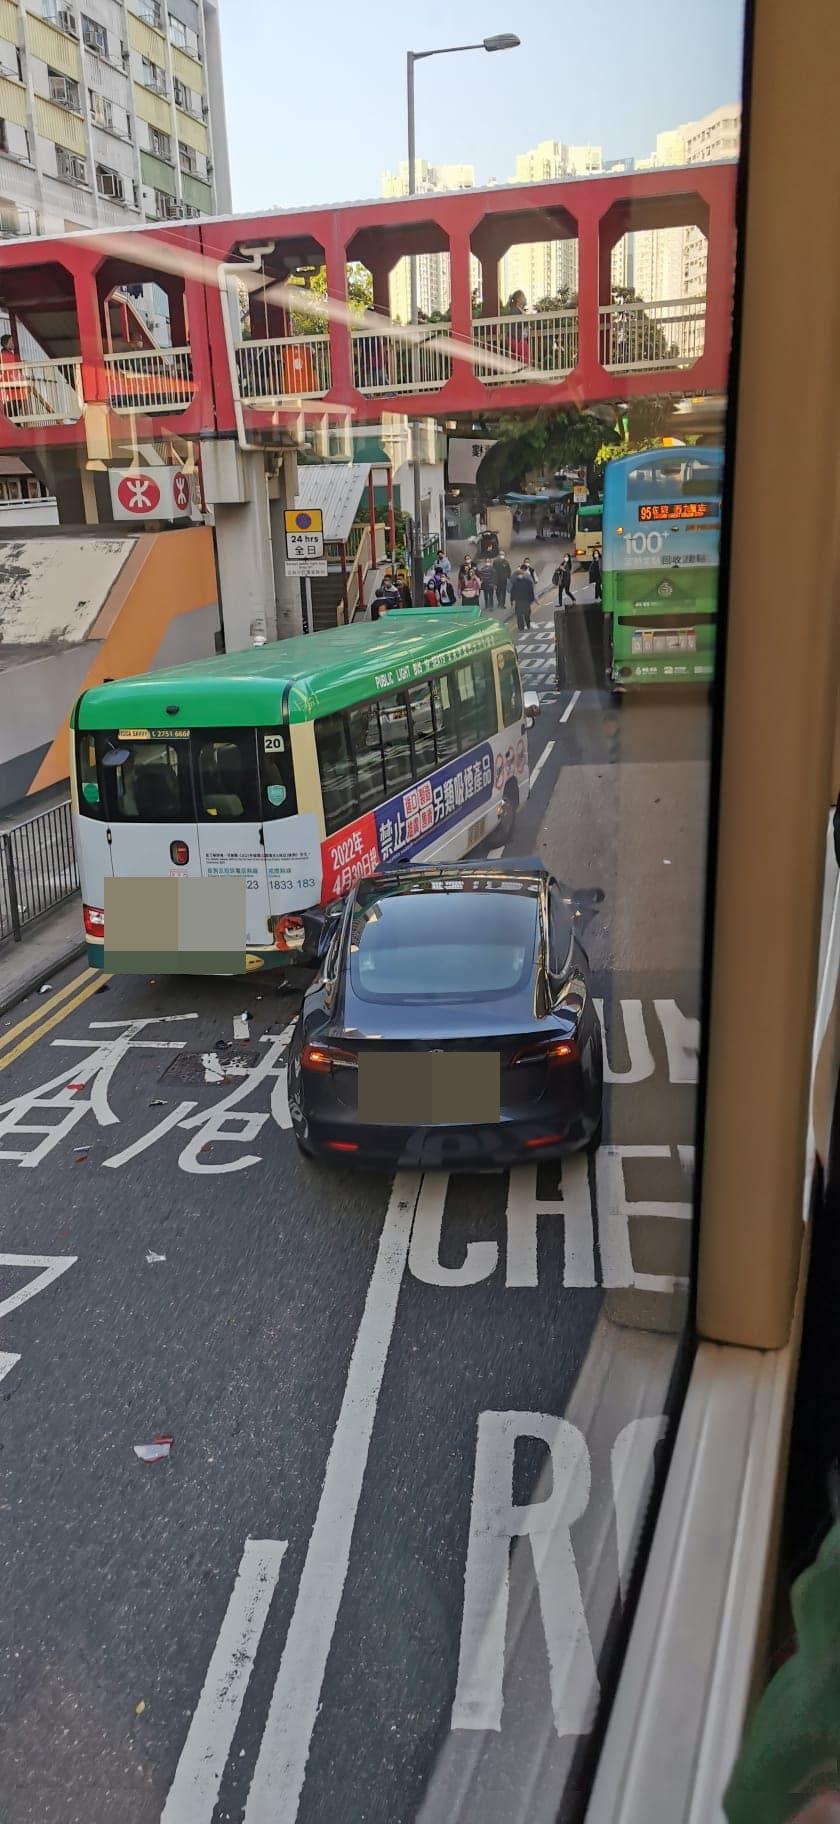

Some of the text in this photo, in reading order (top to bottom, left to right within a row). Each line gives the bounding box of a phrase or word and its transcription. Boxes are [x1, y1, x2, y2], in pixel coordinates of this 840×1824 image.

[640, 506, 651, 520] 95
[291, 535, 319, 543] 24 hrs
[294, 545, 316, 556] 全日
[374, 671, 394, 689] PUBLIC
[396, 665, 410, 681] LIGHT
[265, 738, 281, 749] 20
[379, 812, 406, 860] 禁止
[331, 831, 364, 871] 2022年
[269, 880, 294, 890] 1833
[297, 878, 316, 889] 183
[408, 1144, 695, 1293] CHE
